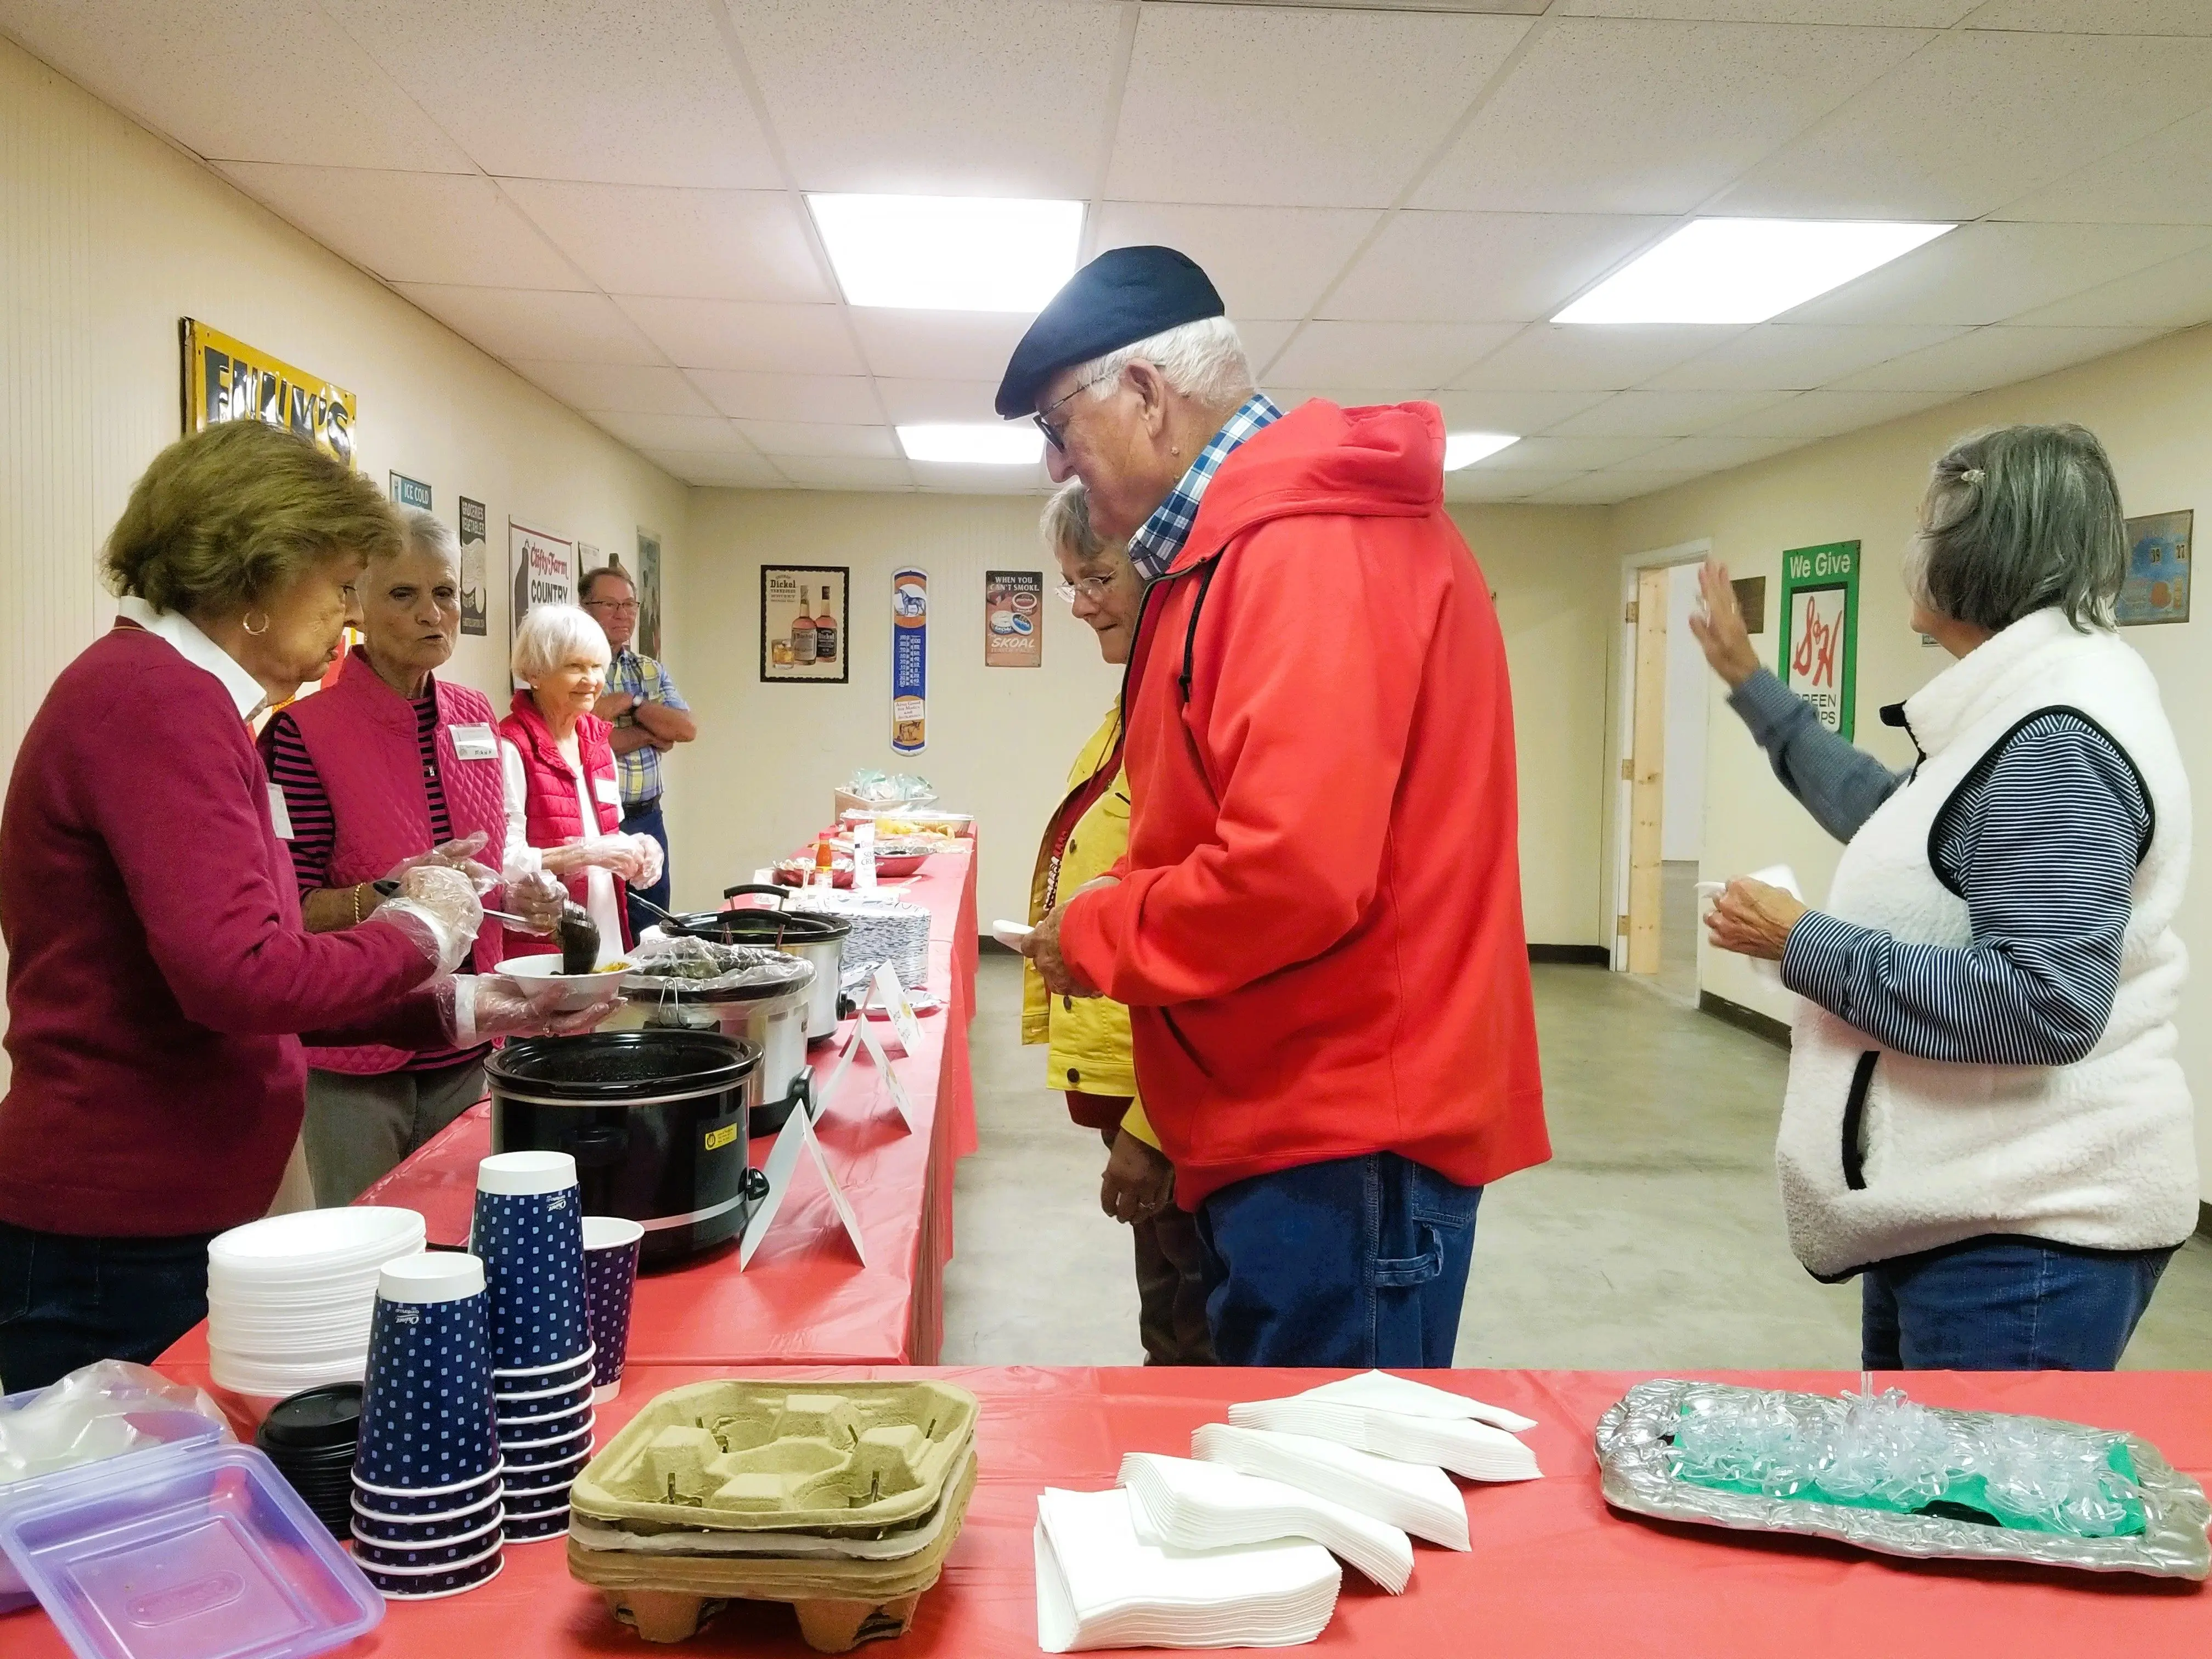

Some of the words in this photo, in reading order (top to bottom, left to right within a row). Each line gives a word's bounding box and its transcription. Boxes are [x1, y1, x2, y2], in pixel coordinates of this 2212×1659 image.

[404, 483, 413, 500] ICE
[415, 487, 429, 505] COLD
[549, 552, 569, 580] Farm
[1790, 555, 1810, 578] We
[1815, 551, 1850, 577] Give
[531, 579, 568, 604] COUNTRY
[770, 579, 796, 588] Dickel
[991, 637, 1035, 647] SKOAL
